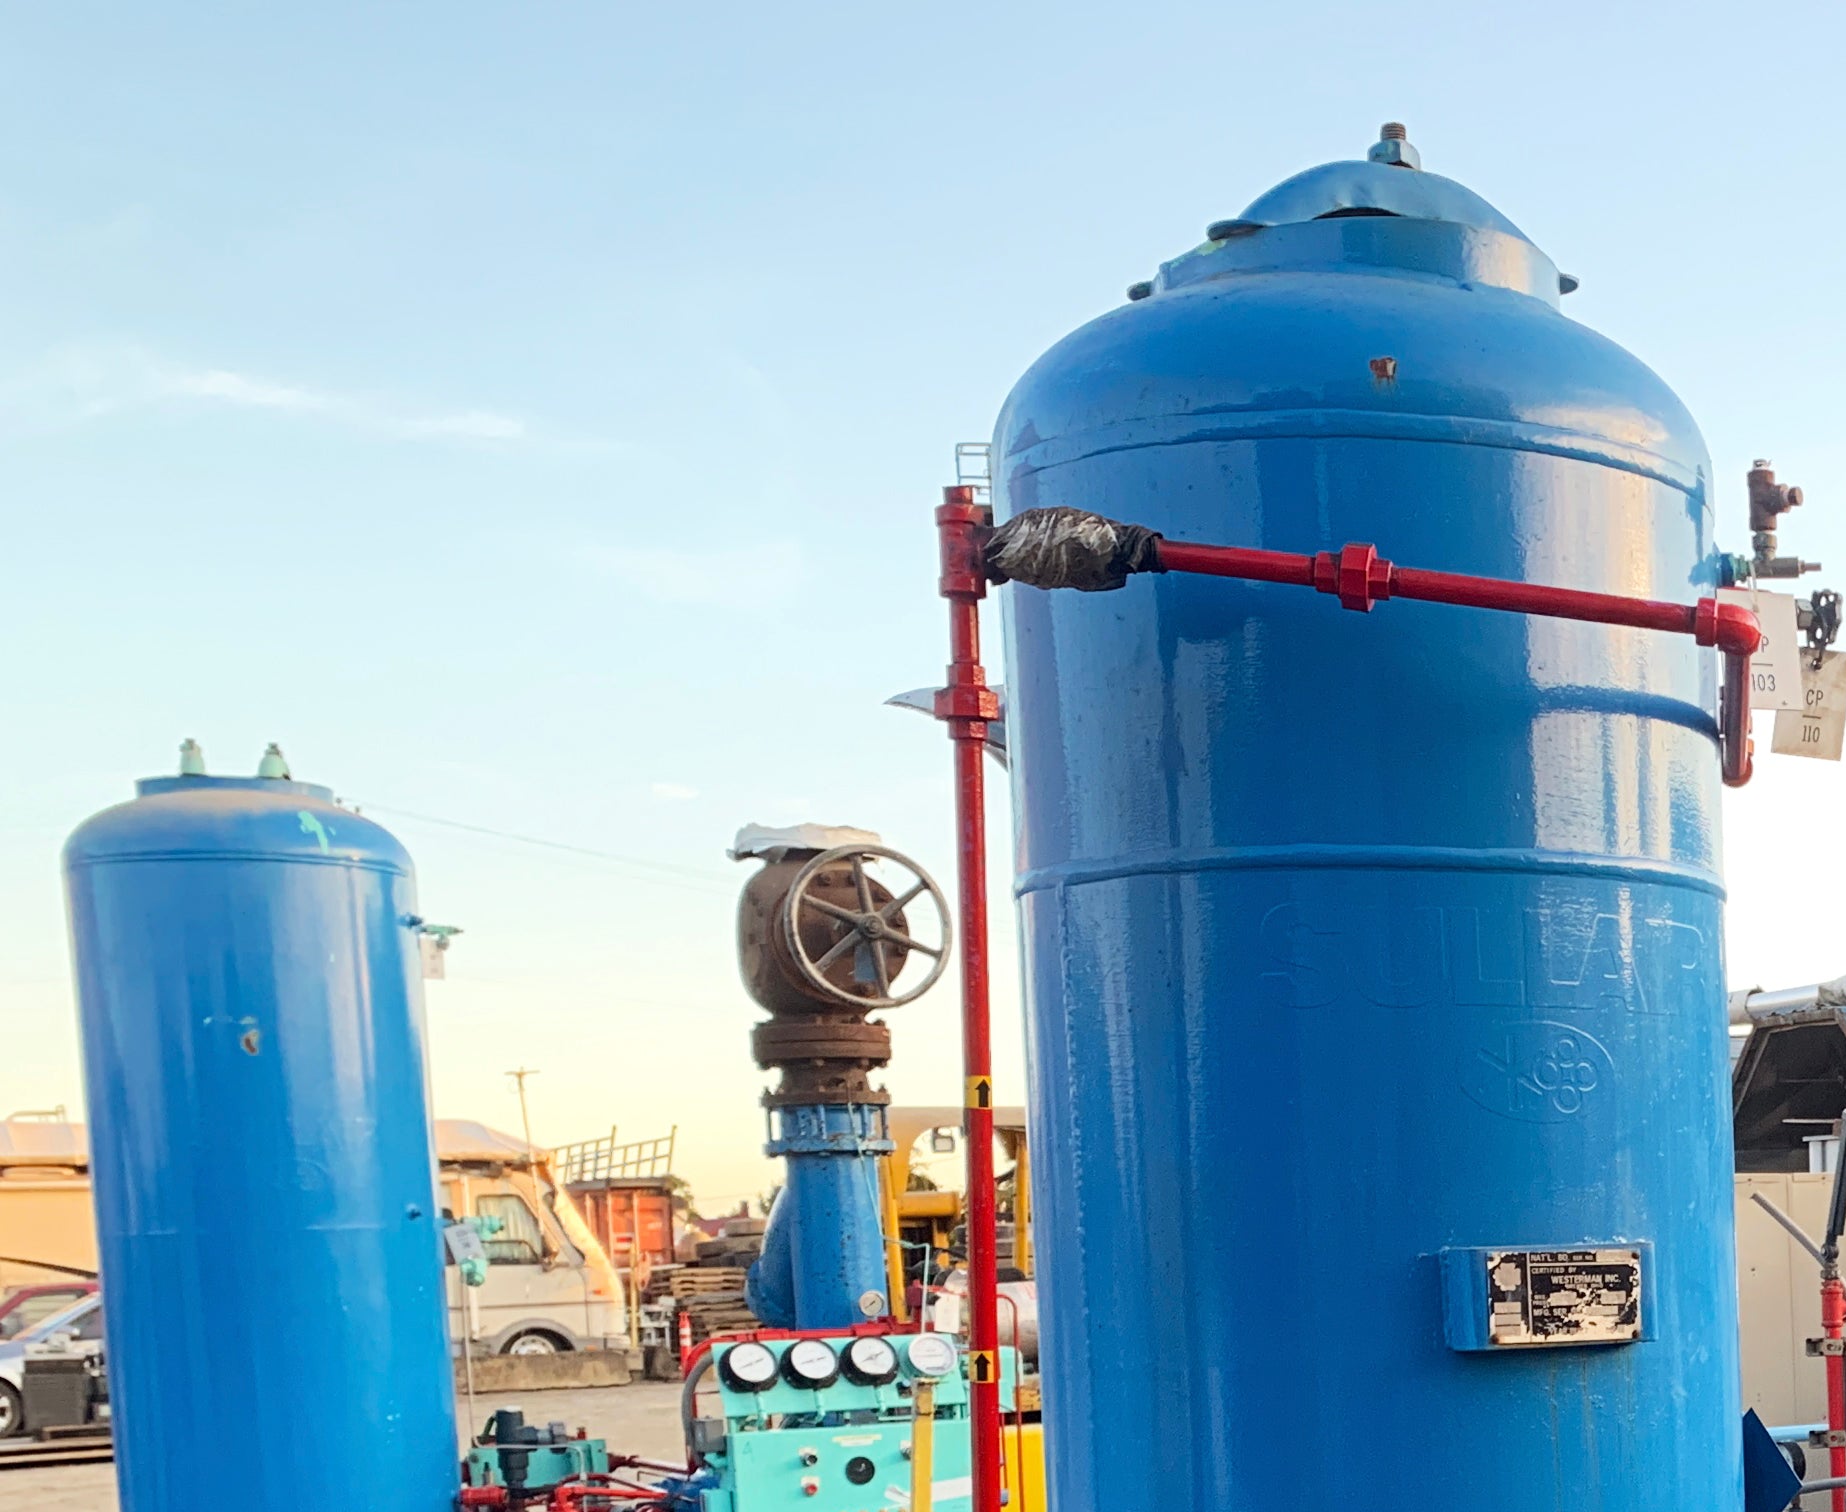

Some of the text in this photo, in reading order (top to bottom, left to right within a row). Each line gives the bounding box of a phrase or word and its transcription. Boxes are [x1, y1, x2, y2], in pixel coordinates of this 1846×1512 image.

[1751, 673, 1776, 692] 103
[1806, 688, 1824, 706] CP
[1801, 725, 1821, 743] 110
[1551, 1274, 1621, 1284] WESTERMAN INC.
